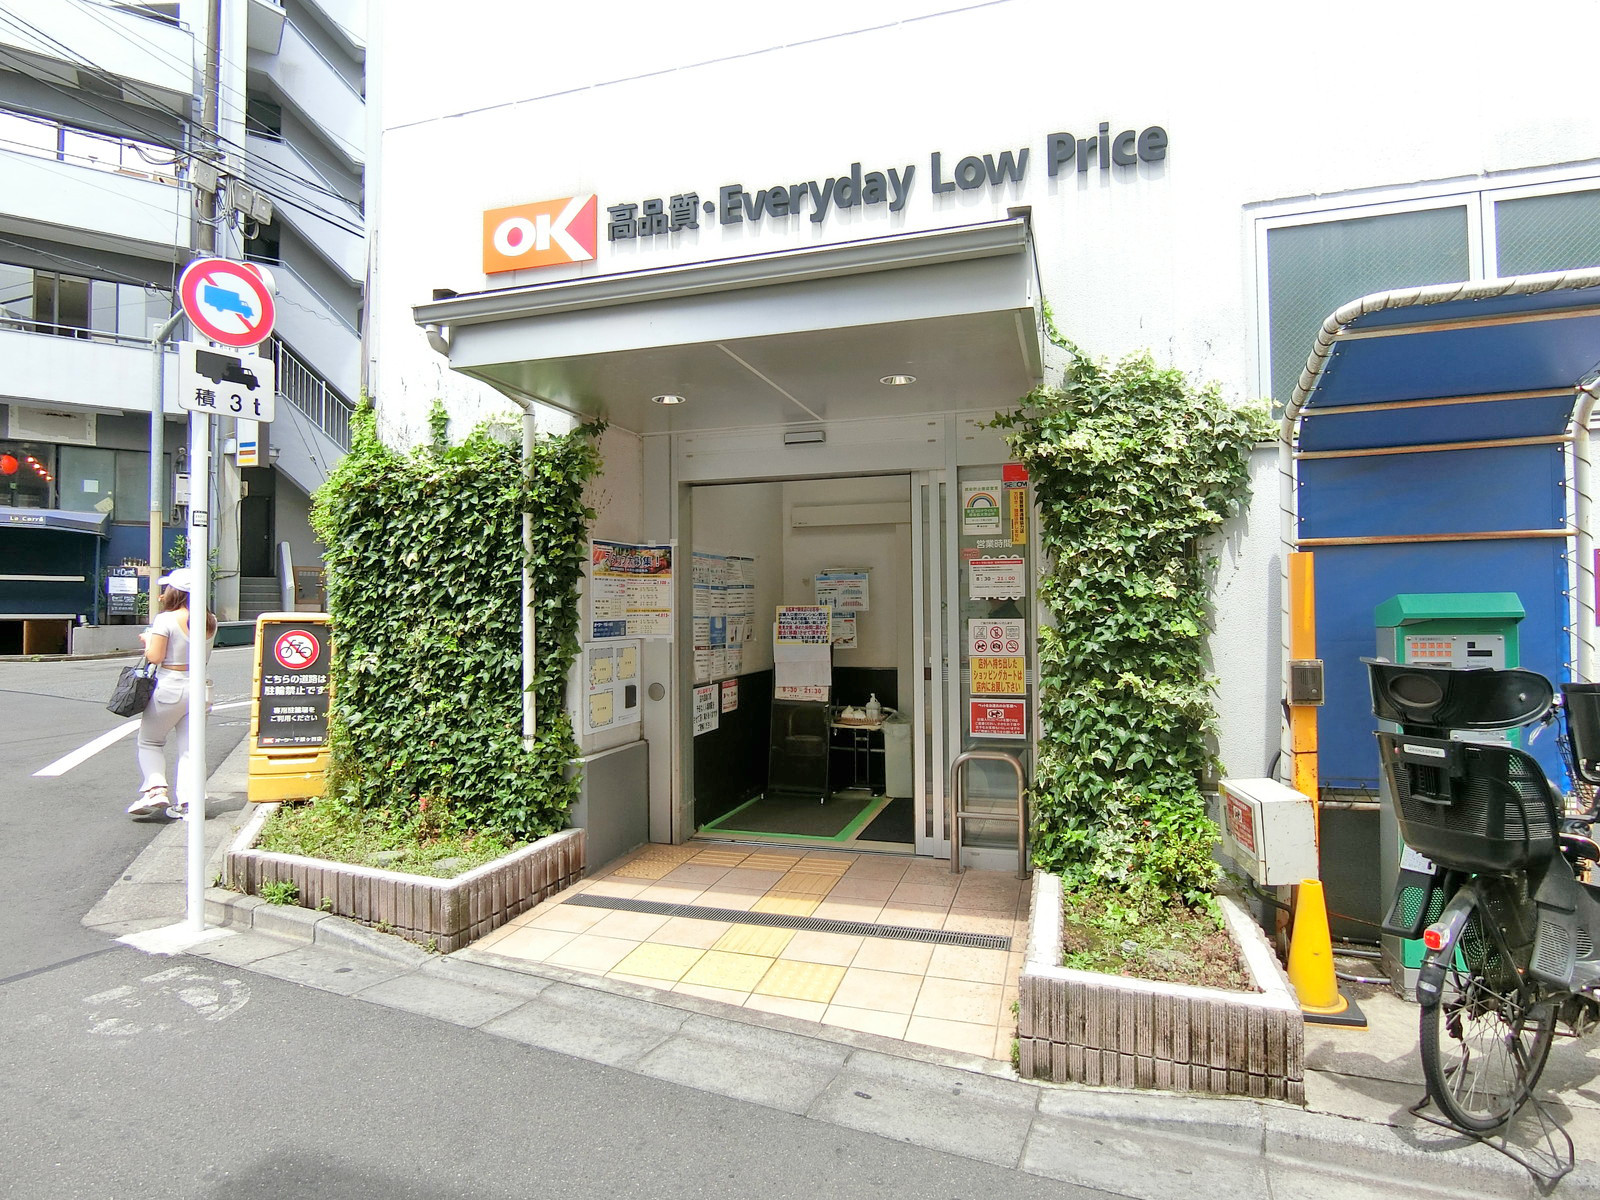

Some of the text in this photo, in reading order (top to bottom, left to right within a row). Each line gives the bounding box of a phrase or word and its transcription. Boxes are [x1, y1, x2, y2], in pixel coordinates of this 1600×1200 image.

[930, 145, 1029, 195] Low
[1046, 121, 1168, 177] Price
[493, 197, 595, 262] OK
[195, 388, 261, 416] 積 3 t
[976, 538, 1012, 549] 営業時間
[978, 658, 1018, 669] 店外へ持ち出した
[264, 674, 327, 684] こちらの道路は
[973, 670, 1022, 680] ショッピングカートは
[264, 685, 325, 696] 駐輪禁止です
[976, 681, 1020, 692] 店内にお戻し下さい
[270, 714, 318, 722] ご利用ください
